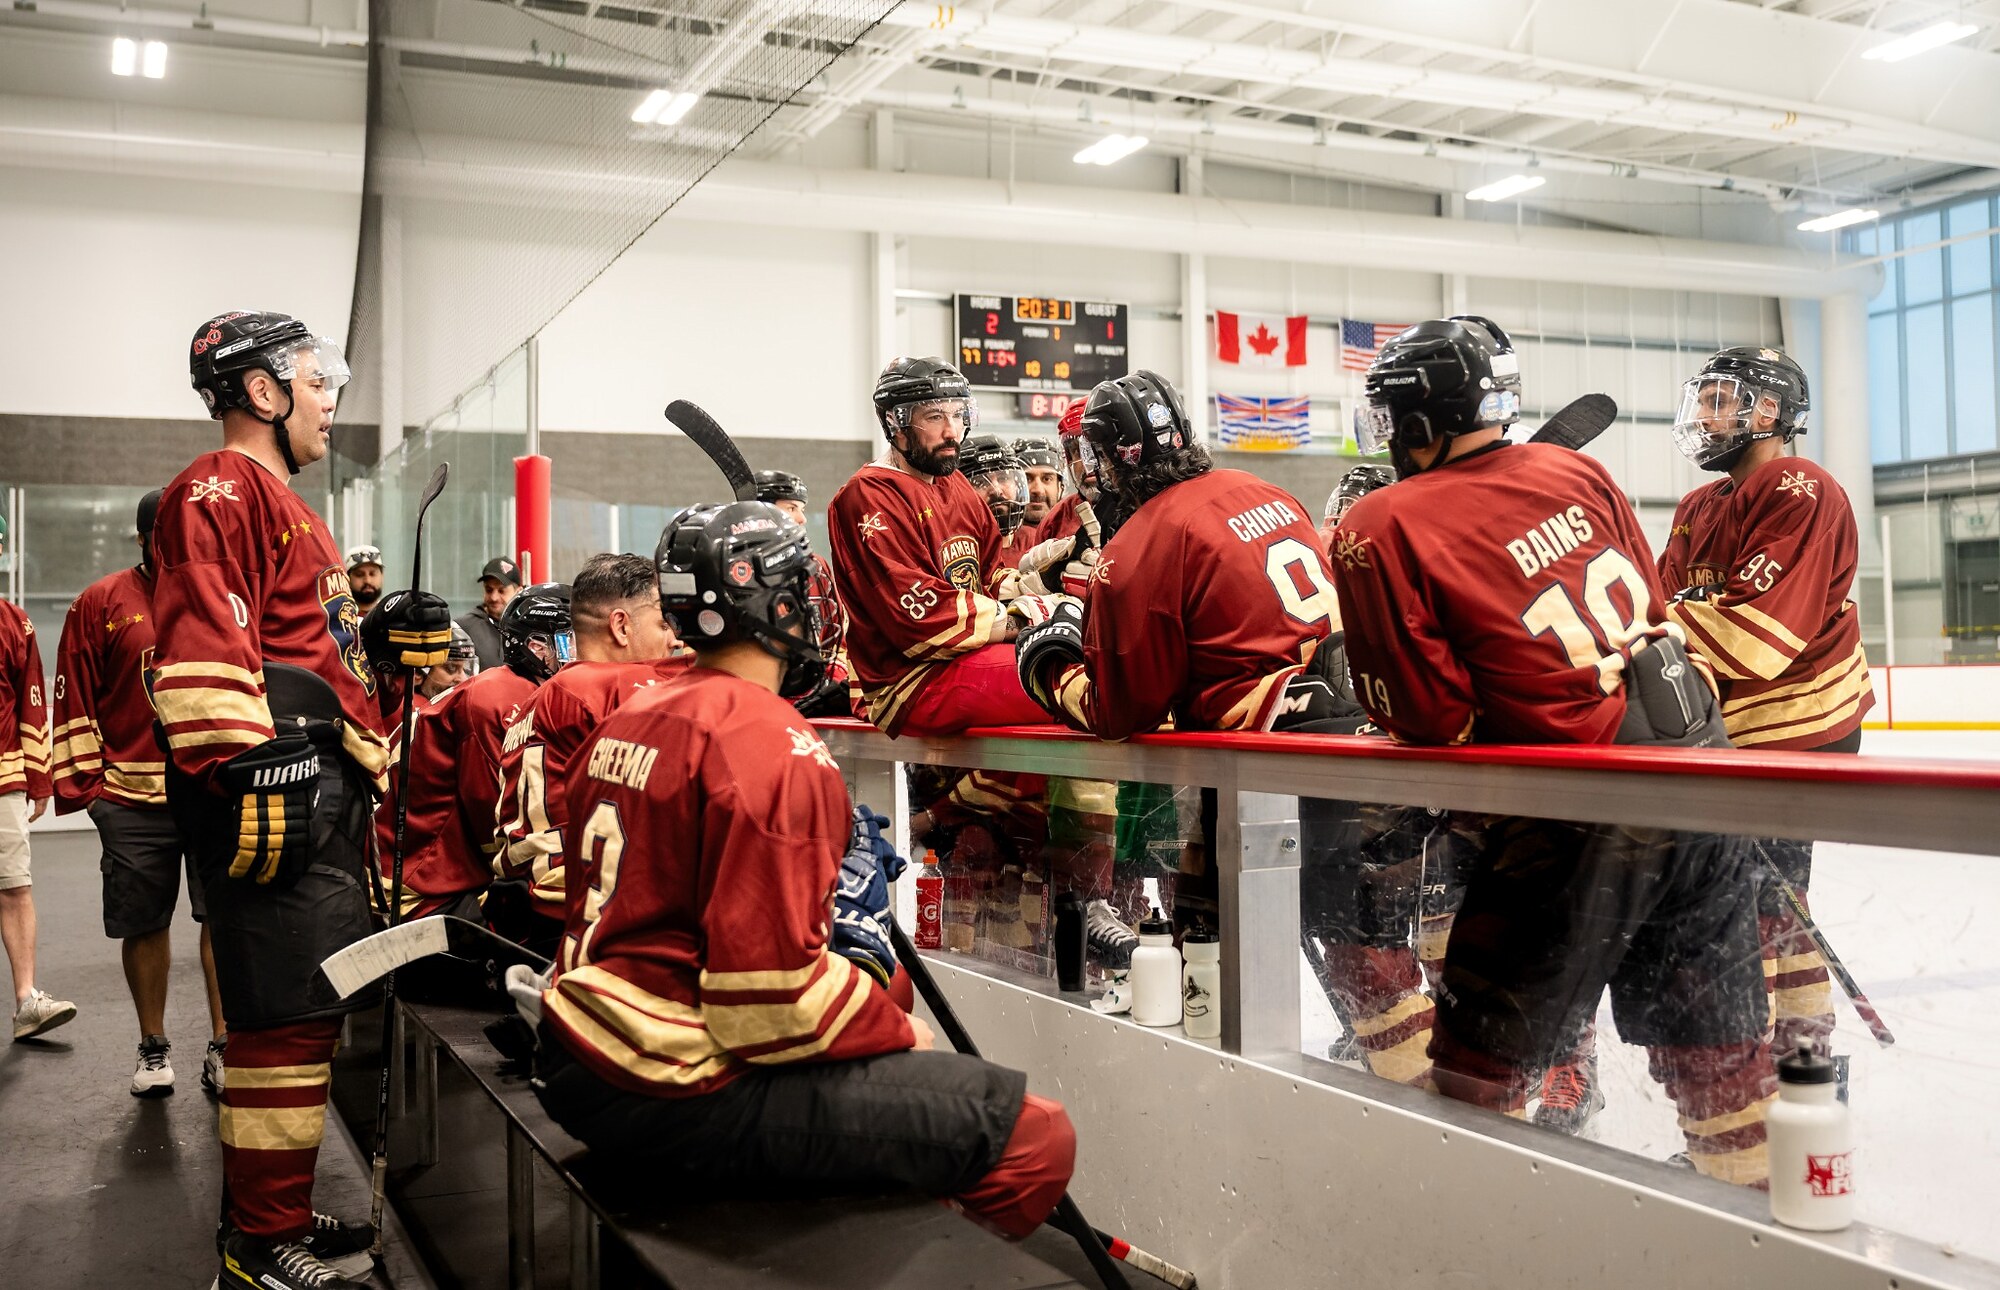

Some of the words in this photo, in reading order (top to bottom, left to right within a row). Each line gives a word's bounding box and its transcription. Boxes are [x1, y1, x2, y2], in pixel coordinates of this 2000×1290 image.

[970, 295, 1001, 310] HOME
[1017, 297, 1071, 319] 20:31
[1084, 303, 1118, 317] GUEST
[985, 312, 999, 335] 2
[1106, 320, 1114, 340] 1
[962, 348, 981, 364] 77
[987, 350, 1017, 367] 1:04
[1383, 376, 1417, 386] BAUER
[1759, 374, 1789, 386] CCM
[978, 451, 1003, 461] CCM
[1227, 500, 1300, 544] CHIMA
[1505, 504, 1594, 579] BAINS
[942, 540, 978, 566] MAMBA
[1739, 553, 1783, 592] 95
[227, 592, 248, 629] 0
[900, 581, 938, 620] 85
[529, 609, 558, 617] BAUER
[30, 685, 42, 707] 63
[55, 674, 66, 700] 3
[1359, 672, 1392, 718] 19
[587, 737, 659, 792] CHEEMA
[923, 904, 938, 921] G
